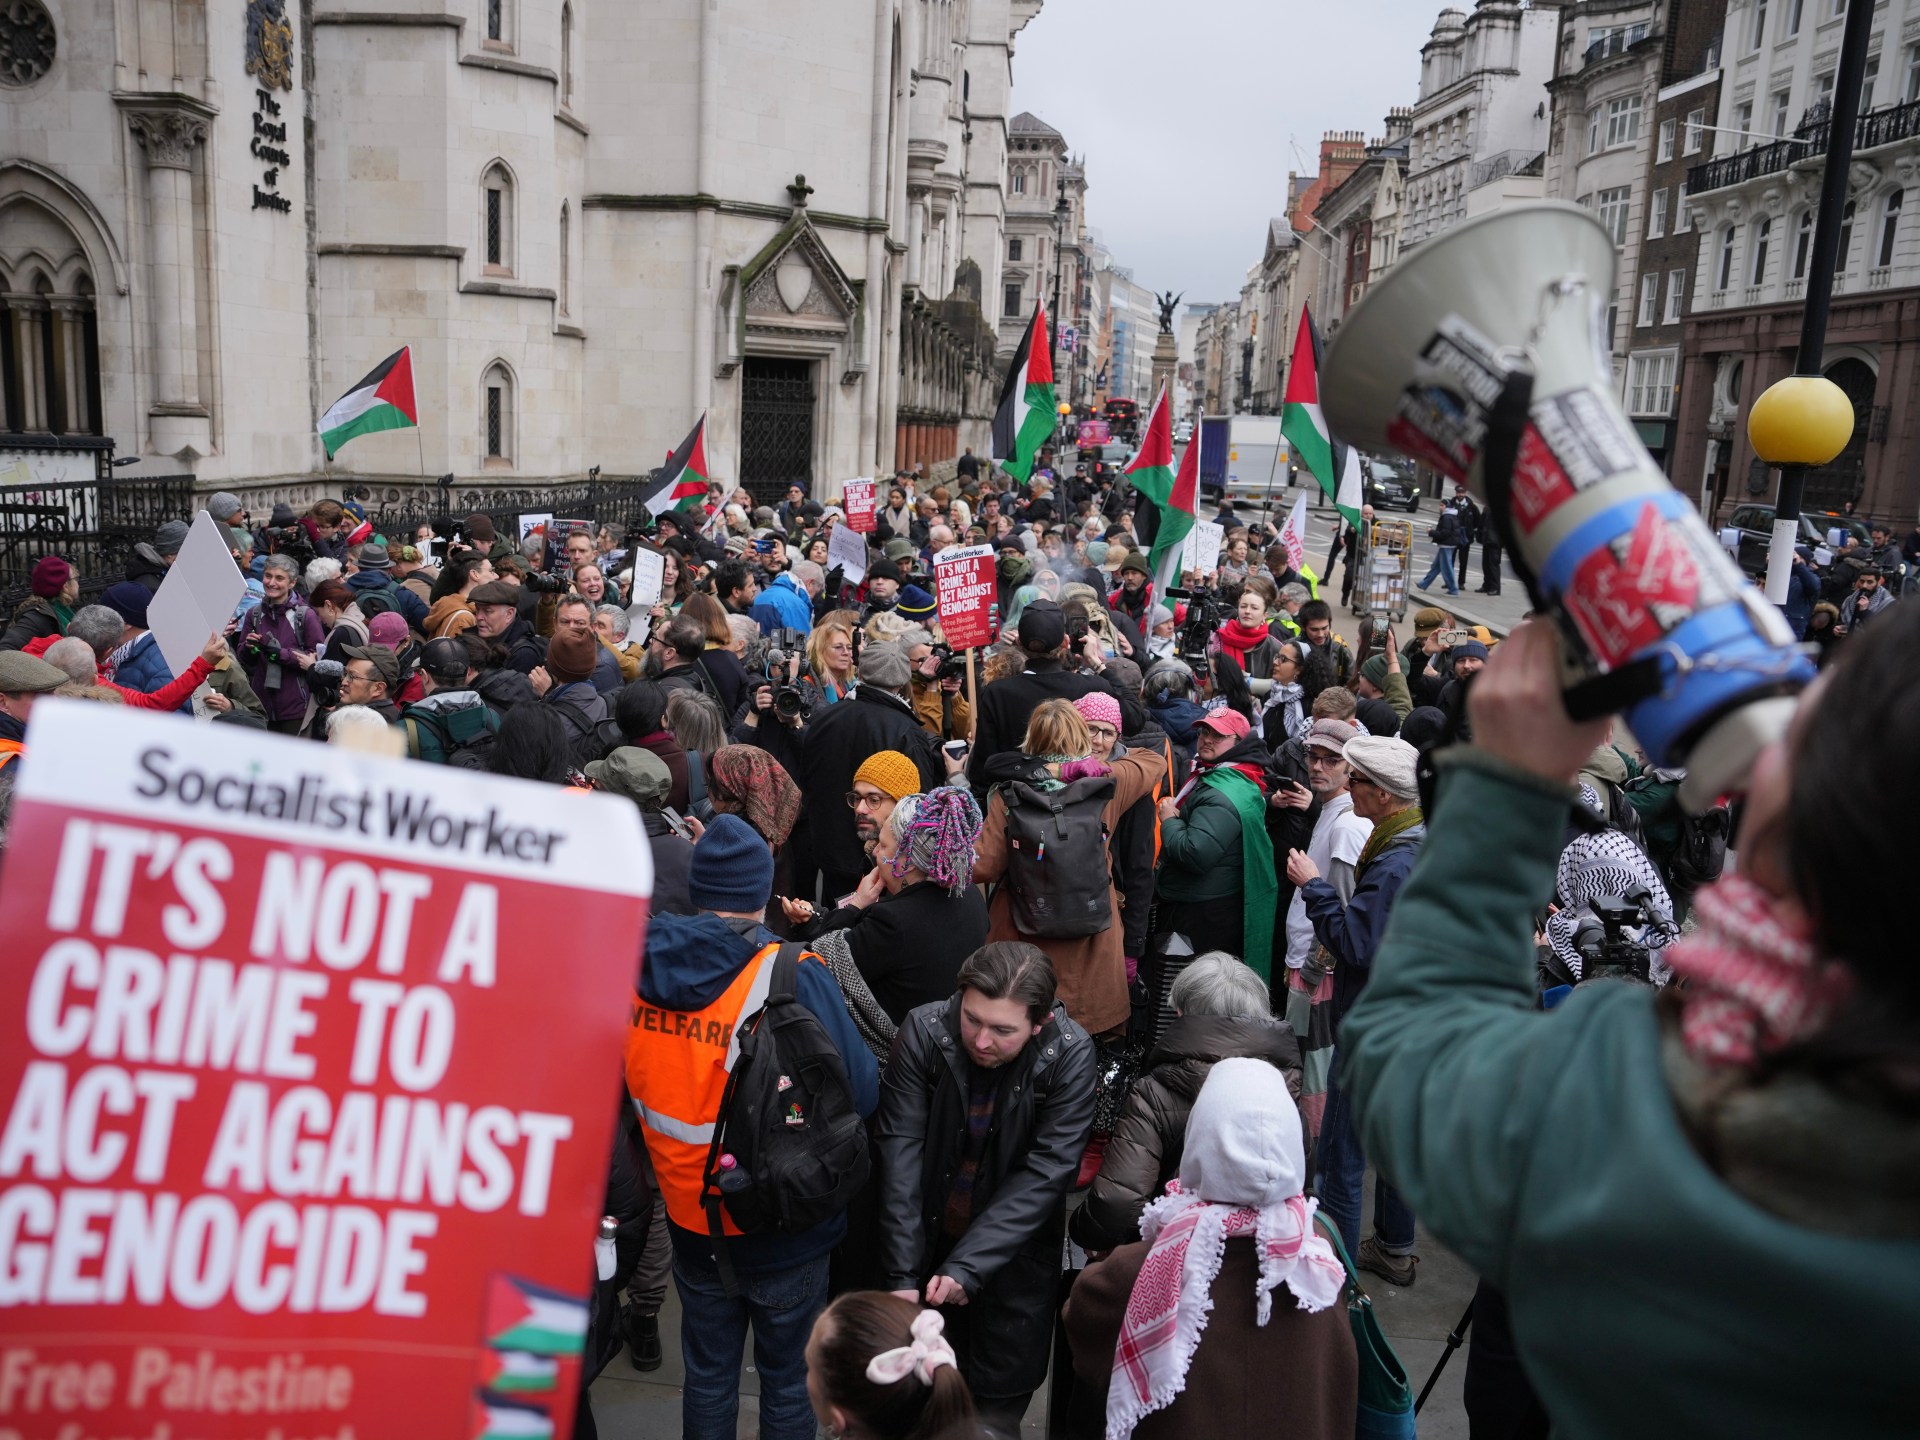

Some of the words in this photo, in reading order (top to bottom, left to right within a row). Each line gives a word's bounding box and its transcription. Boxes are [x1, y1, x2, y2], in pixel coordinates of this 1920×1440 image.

[256, 88, 281, 117] The
[252, 111, 287, 142] Royal
[250, 136, 290, 166] Courts
[263, 166, 279, 187] of
[251, 184, 292, 214] Justice
[938, 563, 954, 578] IT'S
[954, 560, 971, 574] NOT
[973, 558, 980, 570] A
[942, 552, 964, 562] Socialist
[964, 549, 984, 558] Worker
[938, 574, 965, 590] CRIME
[966, 572, 978, 585] TO
[940, 588, 956, 604] ACT
[956, 582, 992, 600] AGAINST
[941, 597, 980, 616] GENOCIDE
[947, 634, 960, 642] ights
[136, 747, 372, 833] Socialist
[384, 791, 567, 864] Worker
[47, 818, 234, 950] IT'S
[250, 848, 433, 975] NOT
[437, 882, 500, 987] A
[27, 938, 330, 1081] CRIME
[349, 977, 455, 1092] TO
[0, 1059, 196, 1184] ACT
[203, 1080, 573, 1218] AGAINST
[0, 1182, 439, 1318] GENOCIDE
[0, 1347, 117, 1414] Free
[127, 1347, 353, 1414] Palestine
